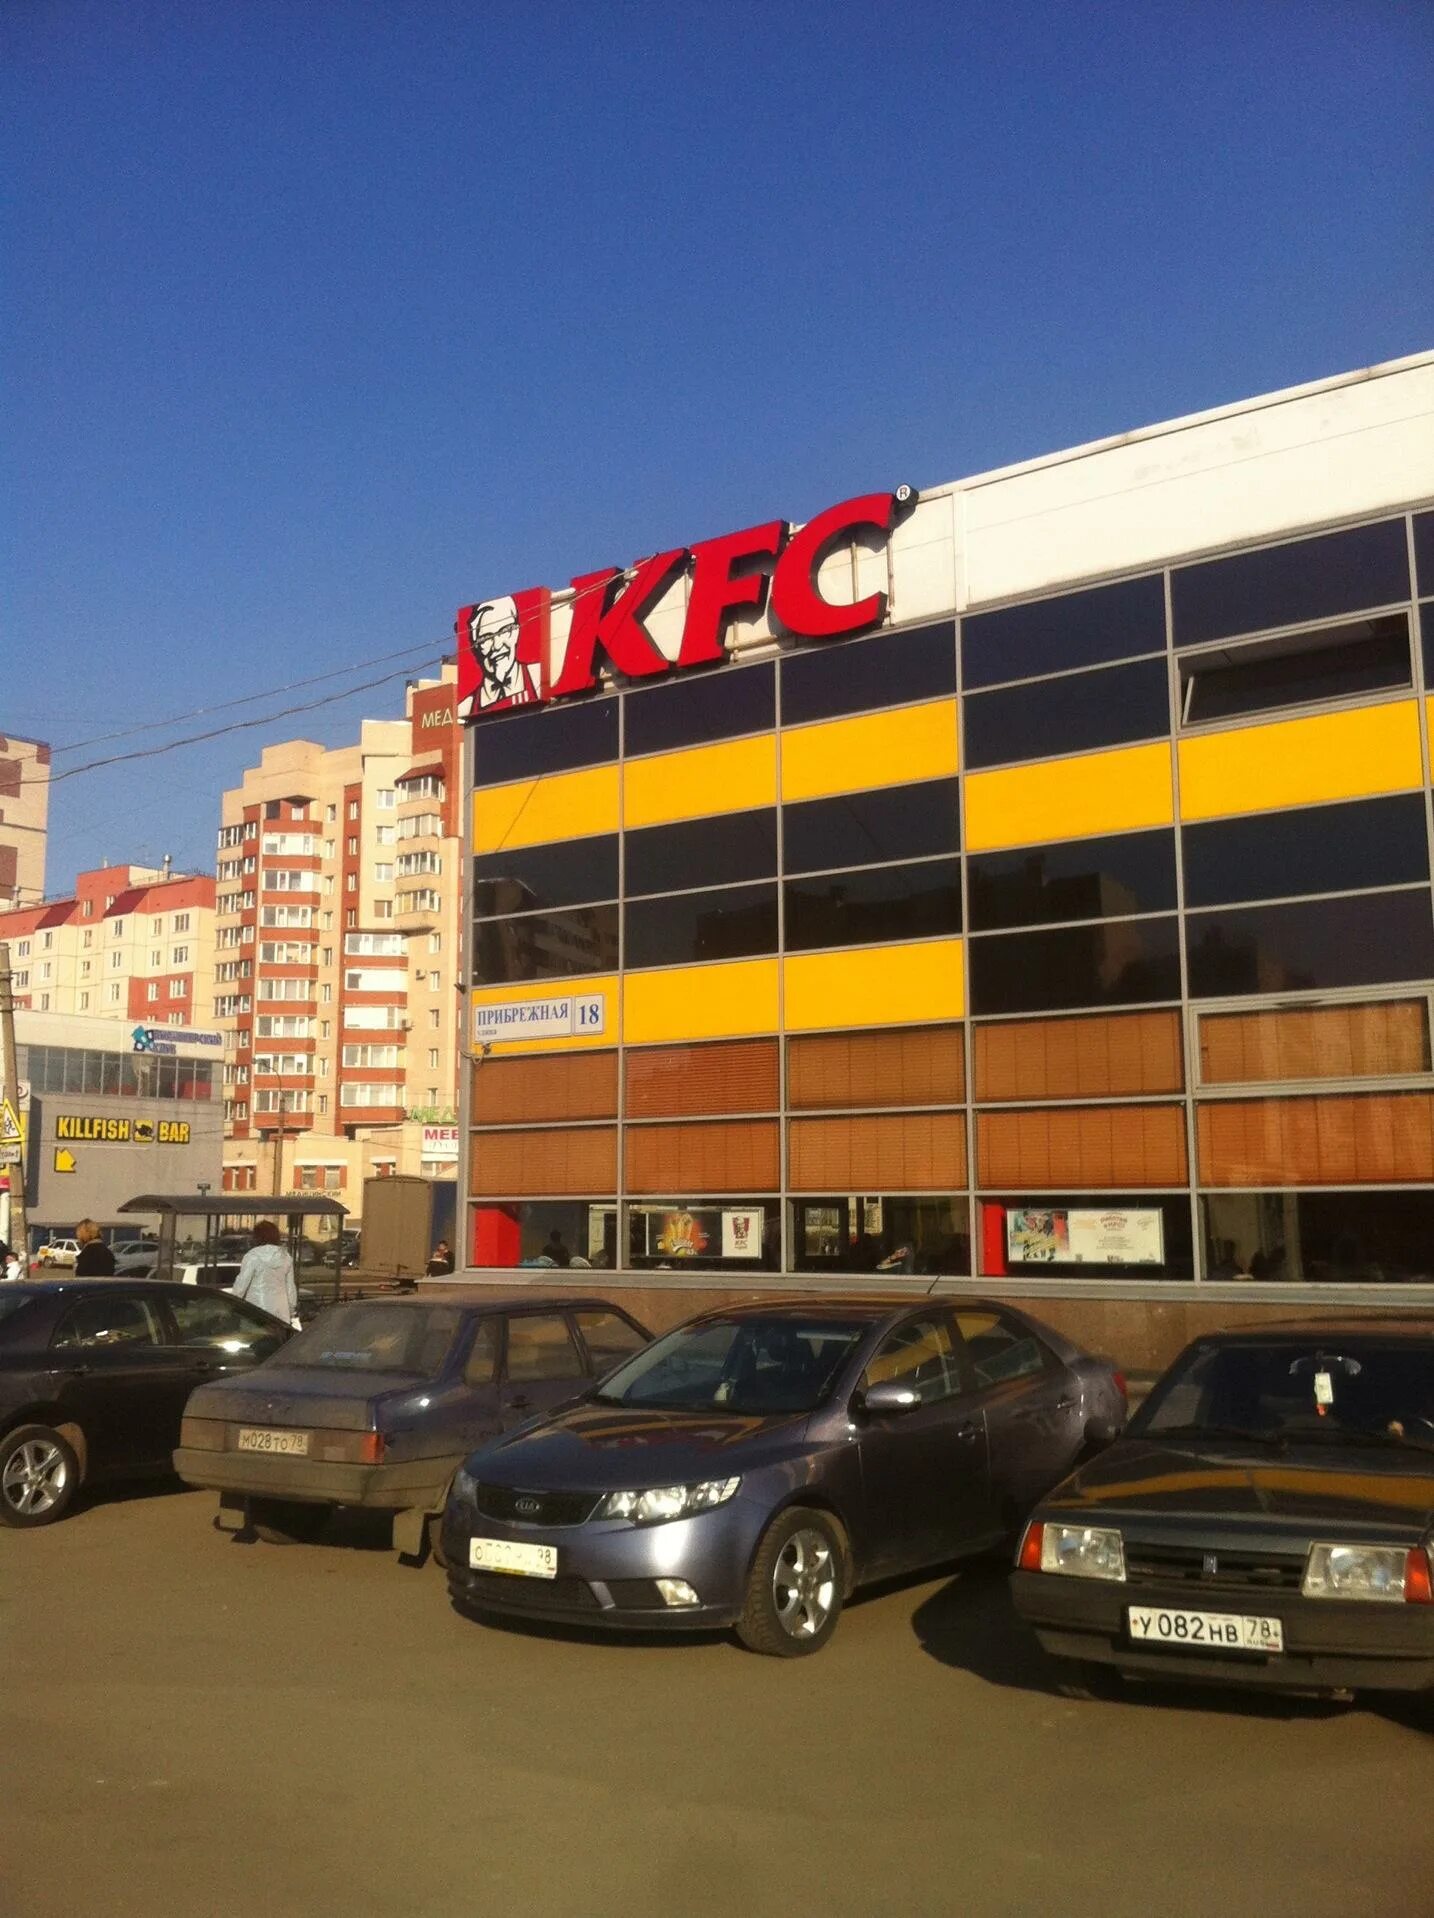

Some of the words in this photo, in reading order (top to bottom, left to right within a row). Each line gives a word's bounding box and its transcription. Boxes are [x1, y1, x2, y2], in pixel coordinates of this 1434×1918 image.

[550, 491, 896, 697] KFC
[421, 708, 454, 728] МЕД
[477, 1002, 569, 1027] ПРИБРЕЖНАЯ
[579, 1003, 600, 1025] 18
[57, 1115, 131, 1141] KILLFISH
[157, 1120, 190, 1144] BAR
[1247, 1618, 1272, 1639] 78
